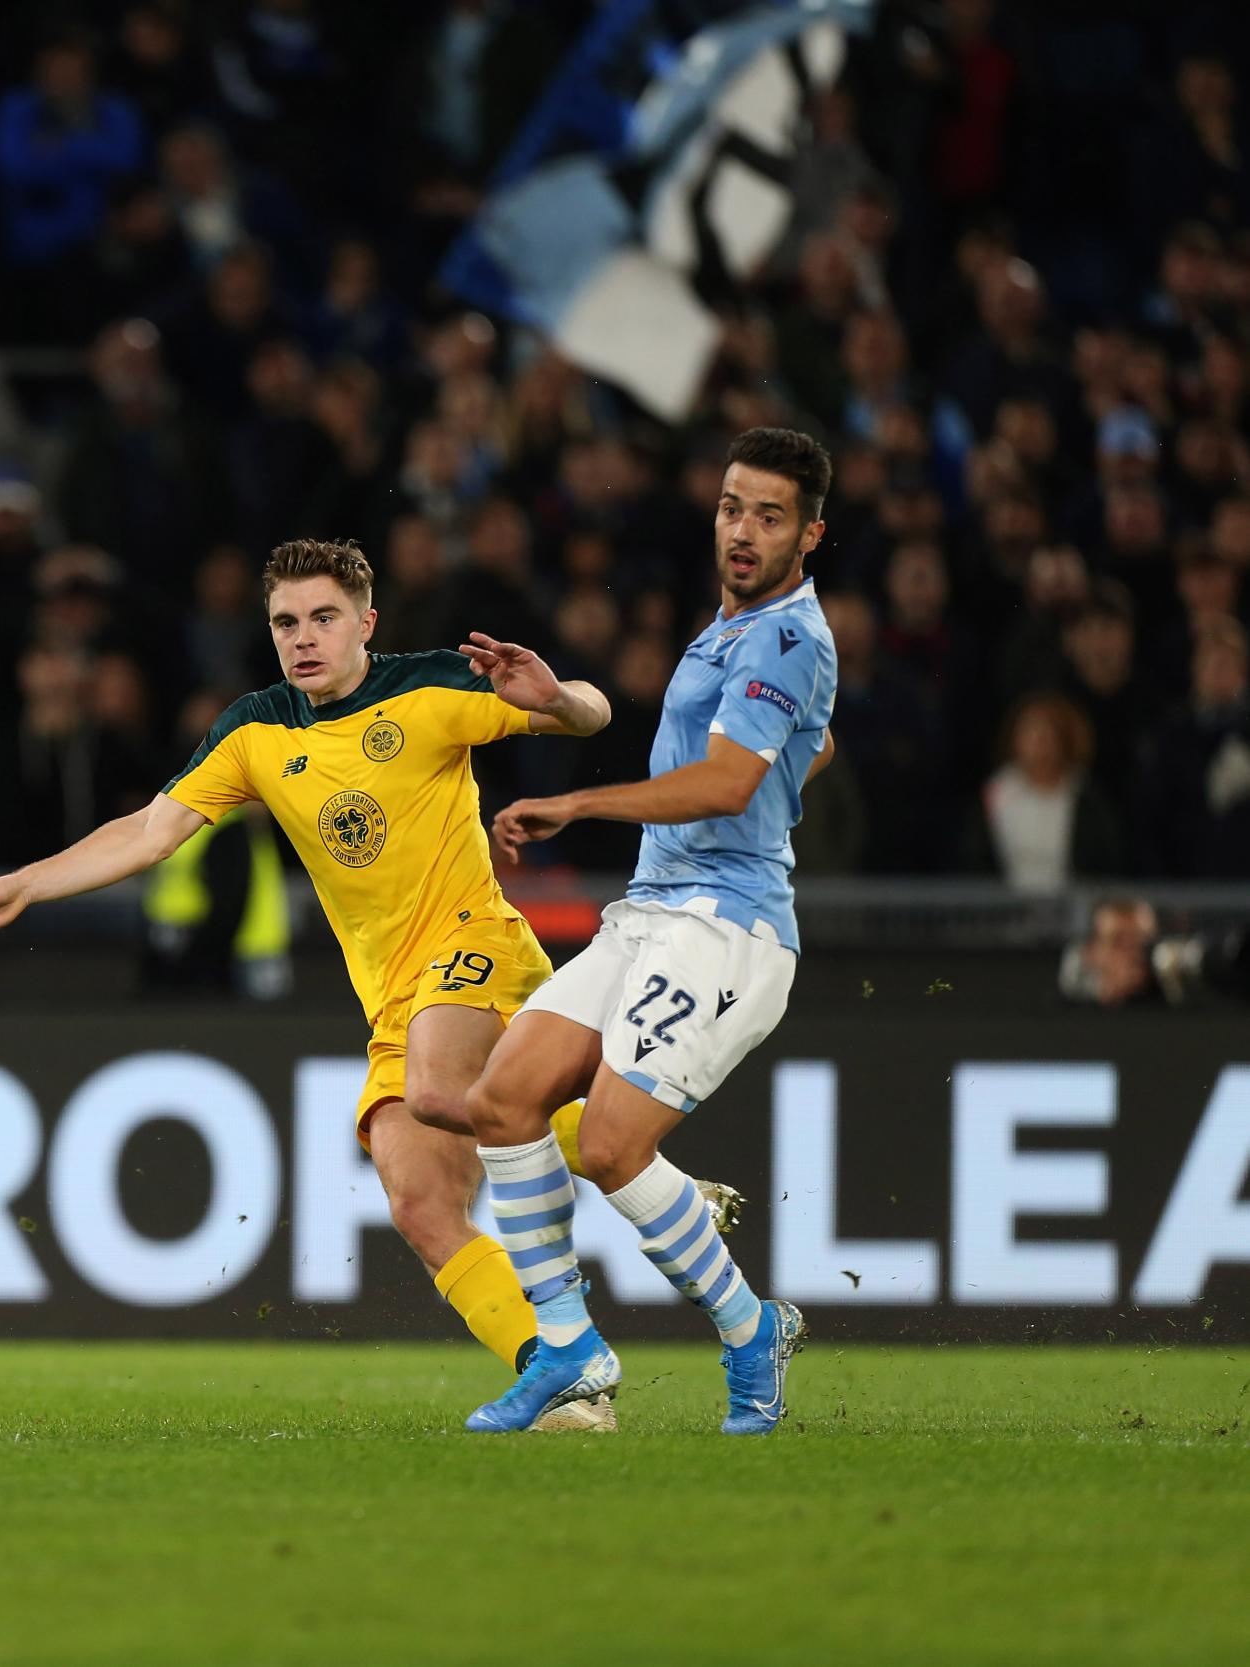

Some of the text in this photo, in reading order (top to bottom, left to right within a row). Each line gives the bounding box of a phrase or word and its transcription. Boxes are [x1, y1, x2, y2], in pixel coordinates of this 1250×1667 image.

[760, 687, 795, 713] RESPECT
[321, 793, 379, 830] CELTIC FC FOUNDATION
[332, 832, 384, 865] FOOTBALL FOR GOOD
[431, 950, 495, 986] 49
[625, 973, 696, 1047] 22
